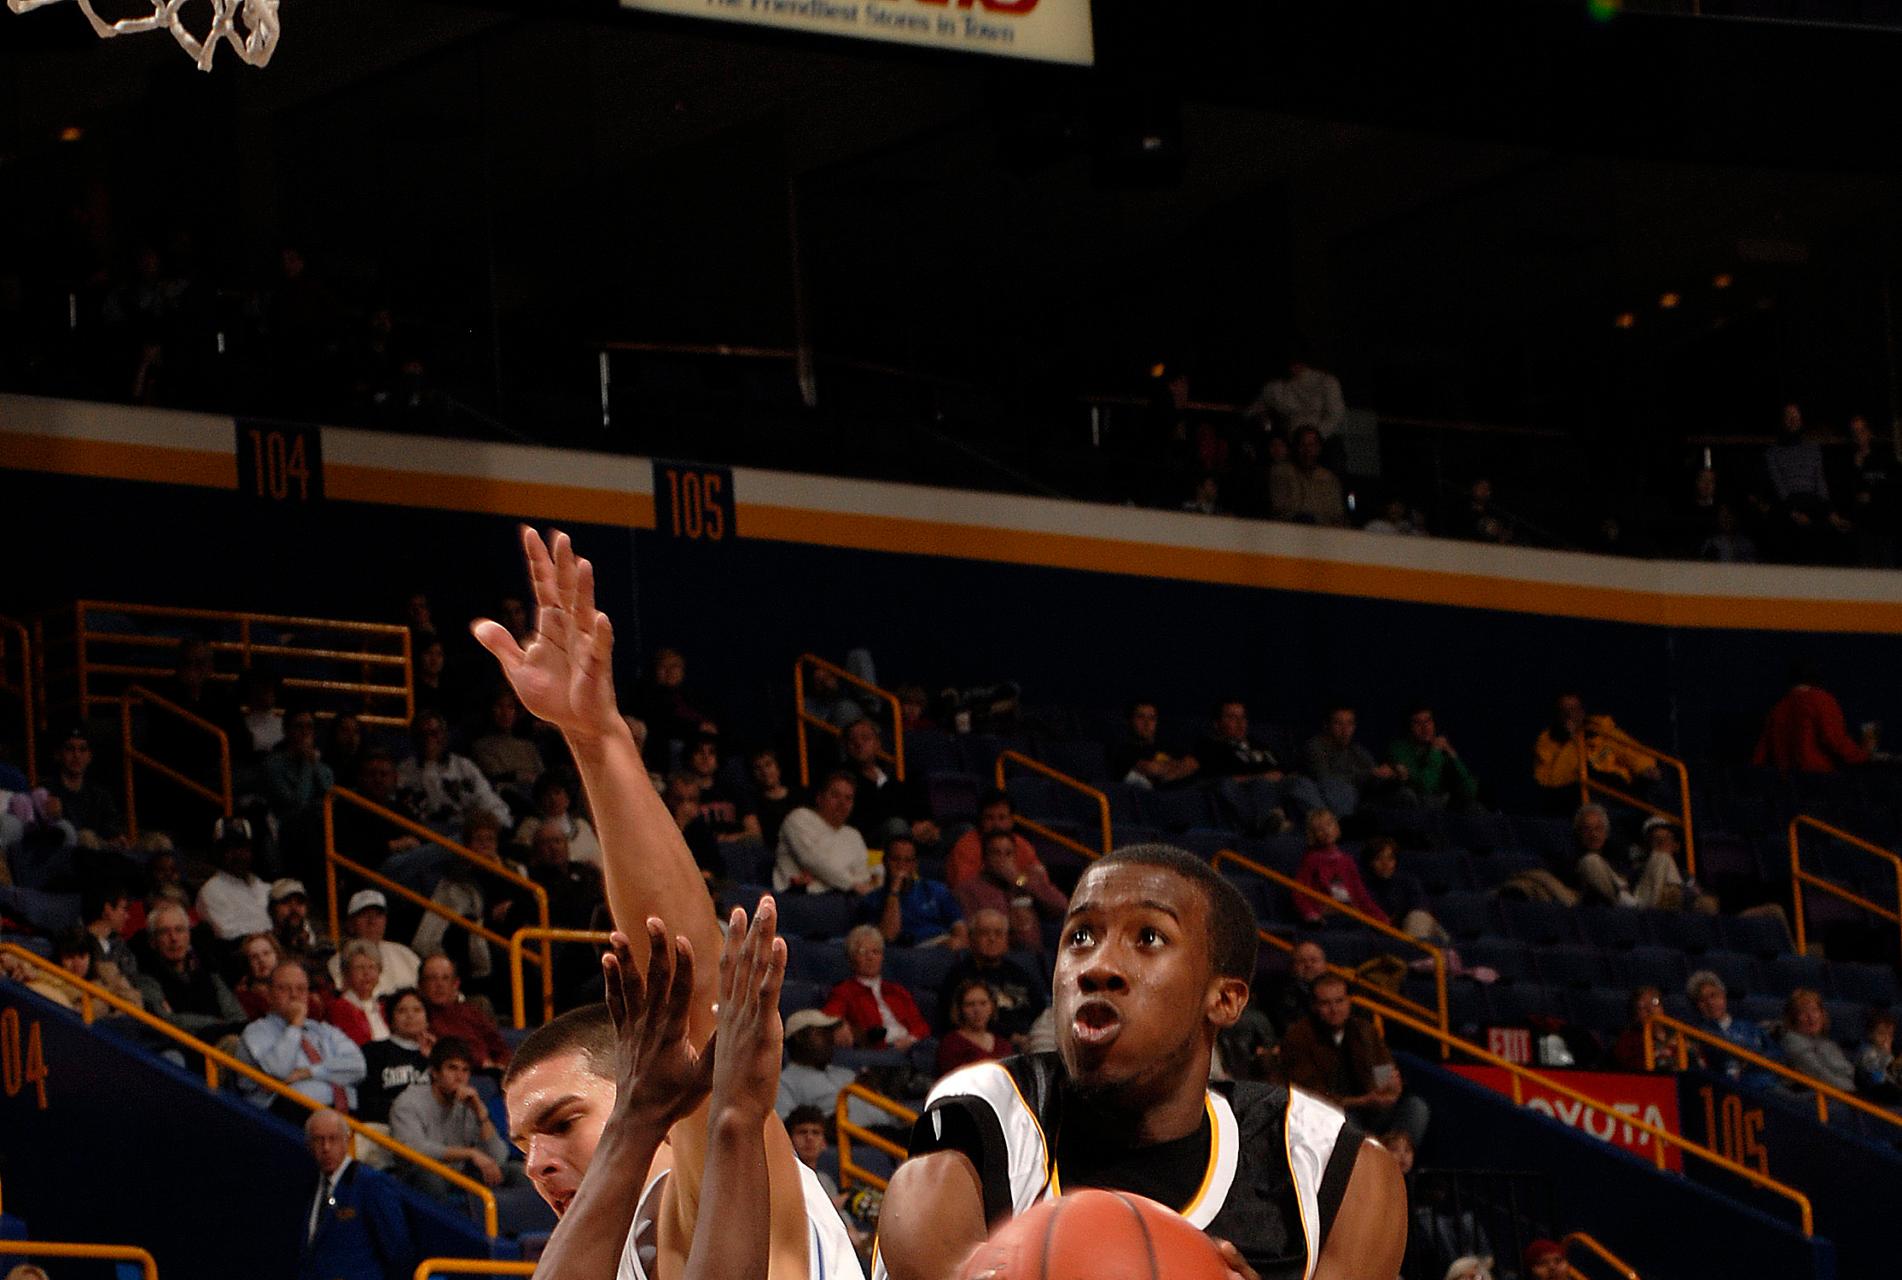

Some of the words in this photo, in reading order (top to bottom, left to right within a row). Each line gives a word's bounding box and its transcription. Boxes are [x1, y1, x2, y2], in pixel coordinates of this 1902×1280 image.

[248, 428, 312, 501] 104
[665, 468, 724, 541] 105
[1, 1007, 49, 1111] 04
[1699, 1086, 1769, 1187] 105
